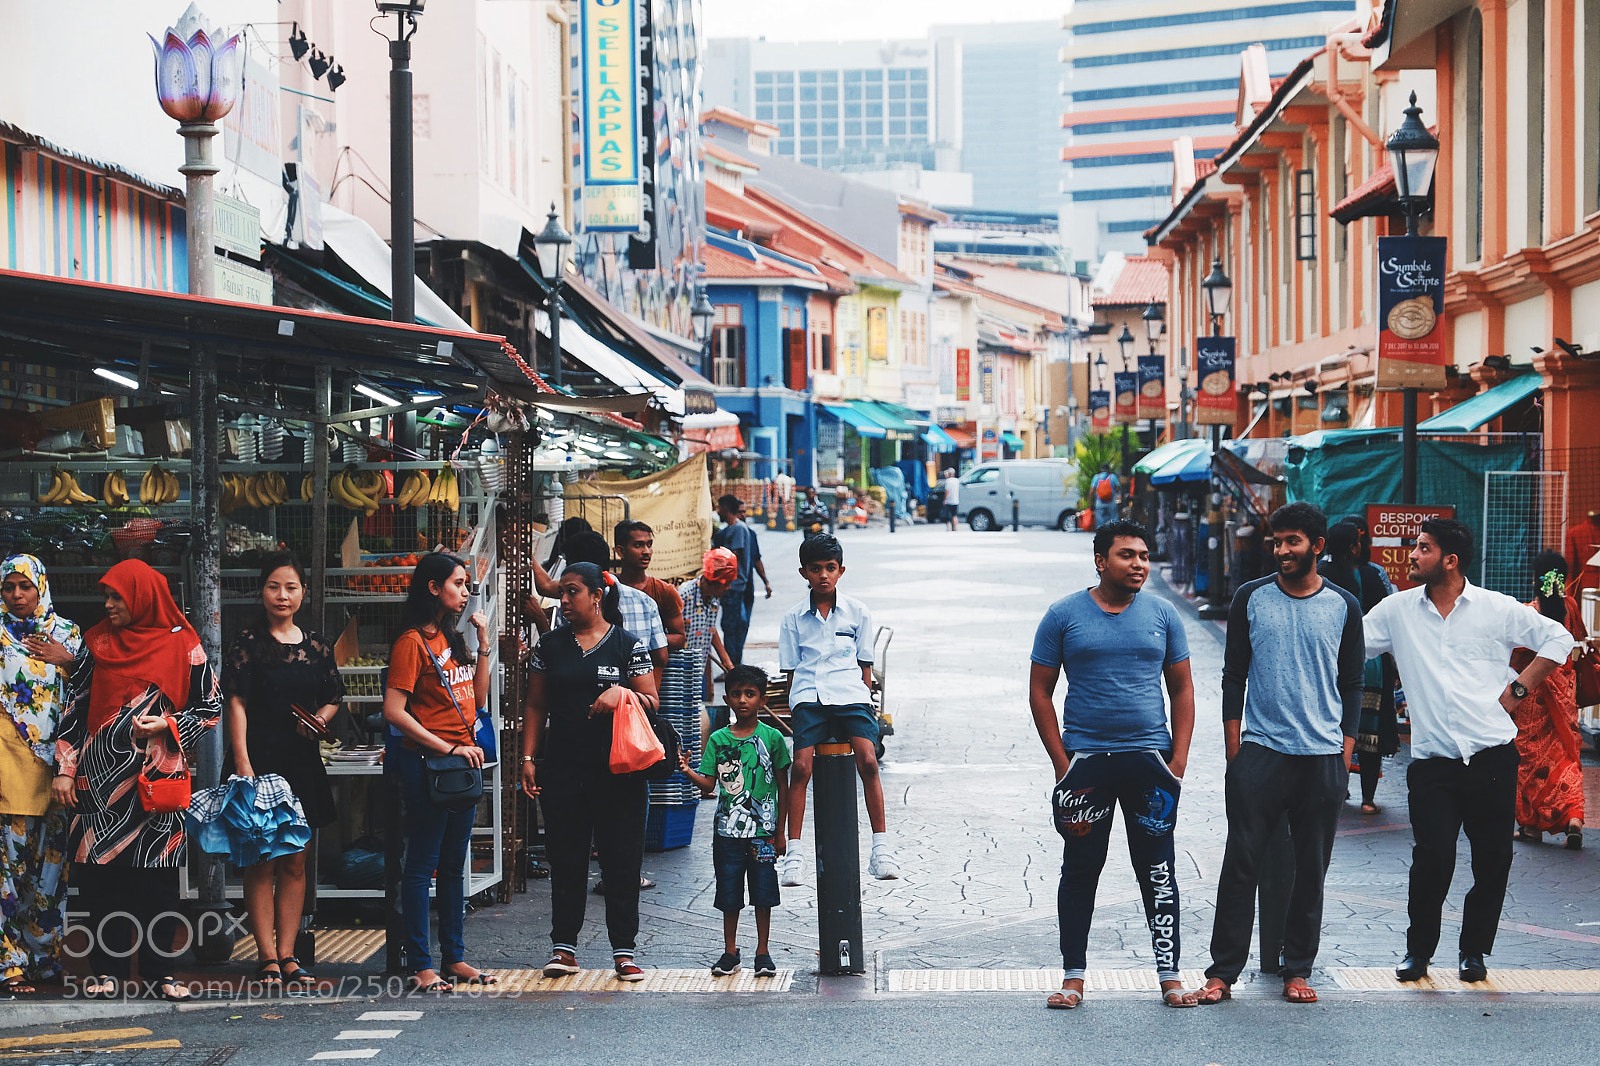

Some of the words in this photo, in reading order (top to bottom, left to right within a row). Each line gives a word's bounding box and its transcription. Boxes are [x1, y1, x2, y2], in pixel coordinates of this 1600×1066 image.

[598, 18, 622, 171] SELLAPPAS
[608, 201, 616, 211] &
[1381, 257, 1432, 274] Symbols
[1418, 271, 1425, 279] &
[1396, 271, 1440, 292] Scripts
[1374, 524, 1422, 536] CLOTHI
[1150, 861, 1174, 909] ROYAL
[1155, 914, 1174, 969] SPORT
